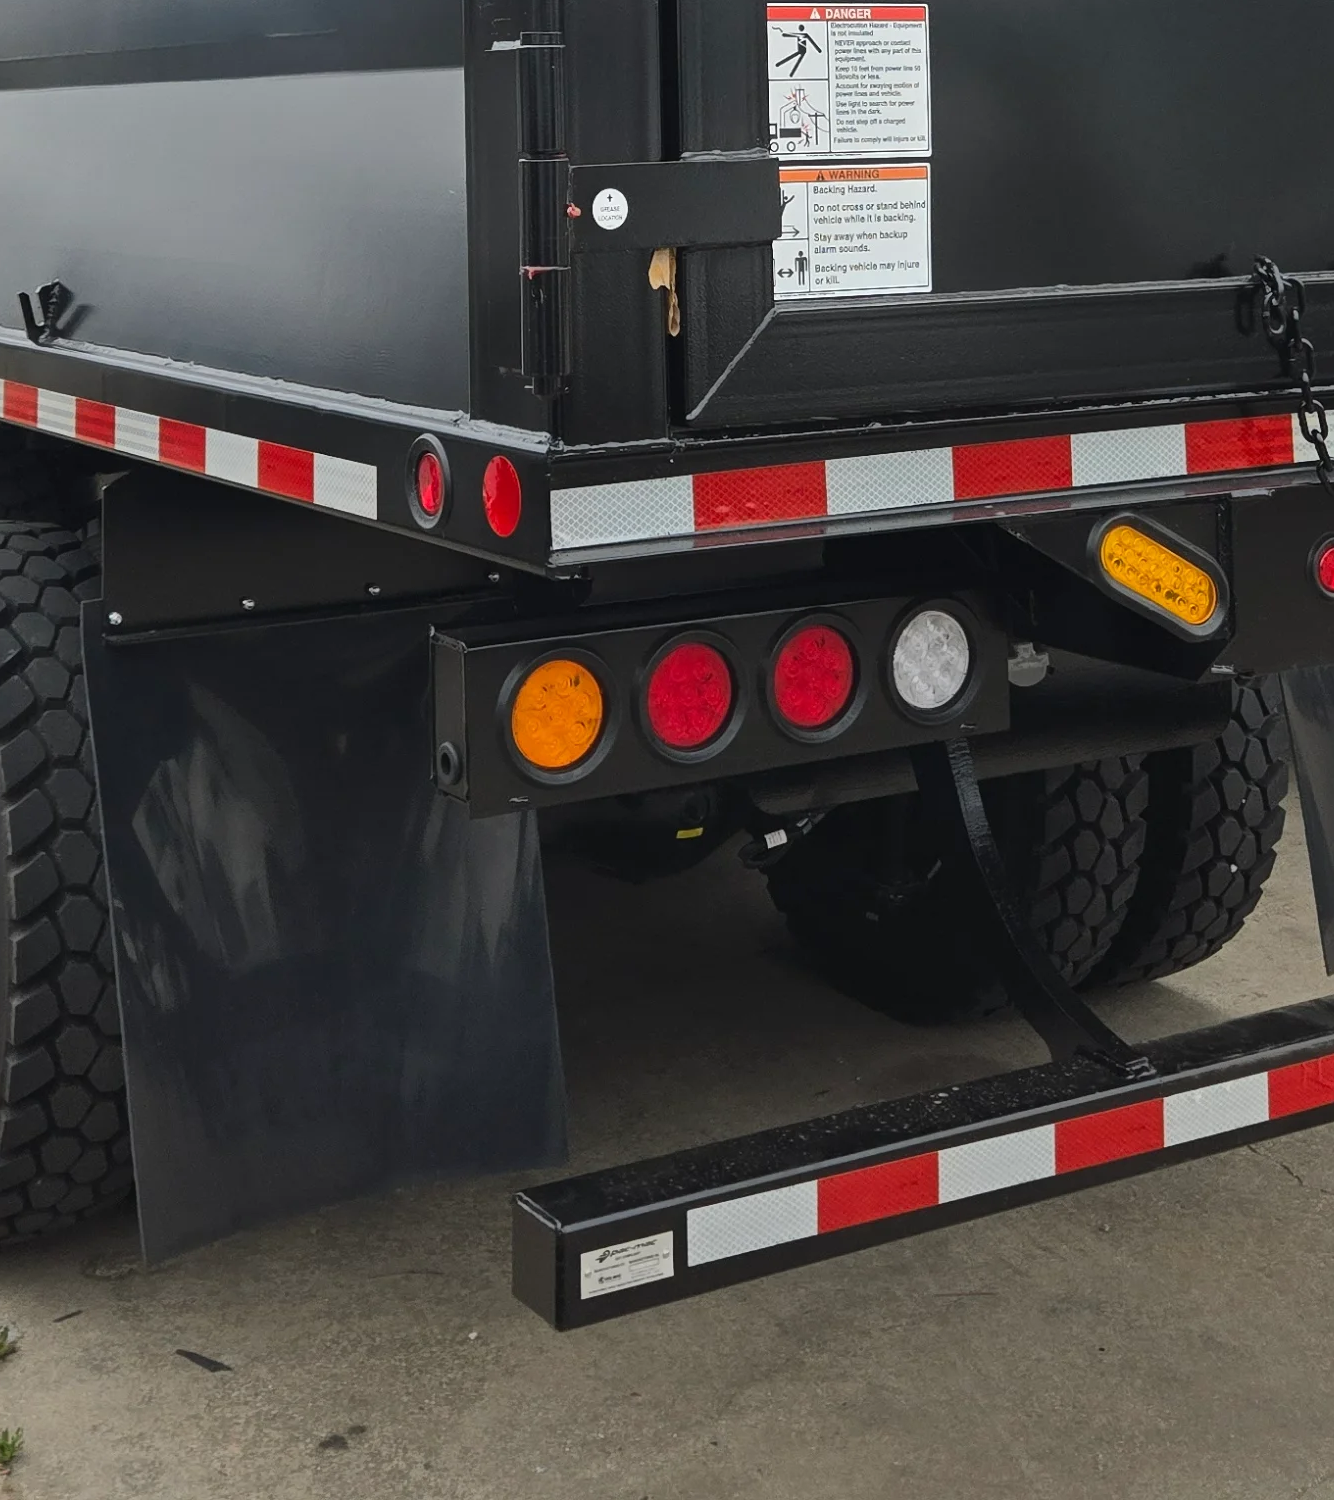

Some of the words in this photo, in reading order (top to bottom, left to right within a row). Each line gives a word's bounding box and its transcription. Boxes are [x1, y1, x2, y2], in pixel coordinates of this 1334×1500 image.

[826, 9, 871, 18] DANGER
[828, 169, 880, 180] WARNING
[813, 186, 845, 195] Backing
[848, 184, 878, 193] Hazard.
[814, 204, 825, 212] Do
[827, 203, 840, 212] not
[876, 201, 898, 210] stand
[900, 200, 926, 209] behind
[813, 216, 842, 225] vehicle
[844, 215, 865, 224] while
[874, 214, 881, 222] is
[883, 213, 916, 223] backing.
[814, 232, 832, 243] Stay
[833, 233, 854, 242] away
[856, 231, 877, 240] when
[879, 231, 908, 240] backup
[814, 245, 837, 254] alarm
[839, 244, 870, 253] sounds.
[815, 264, 847, 274] Backing
[849, 263, 877, 271] vehicle
[879, 262, 896, 271] may
[897, 260, 920, 270] injure
[826, 276, 840, 284] kill.
